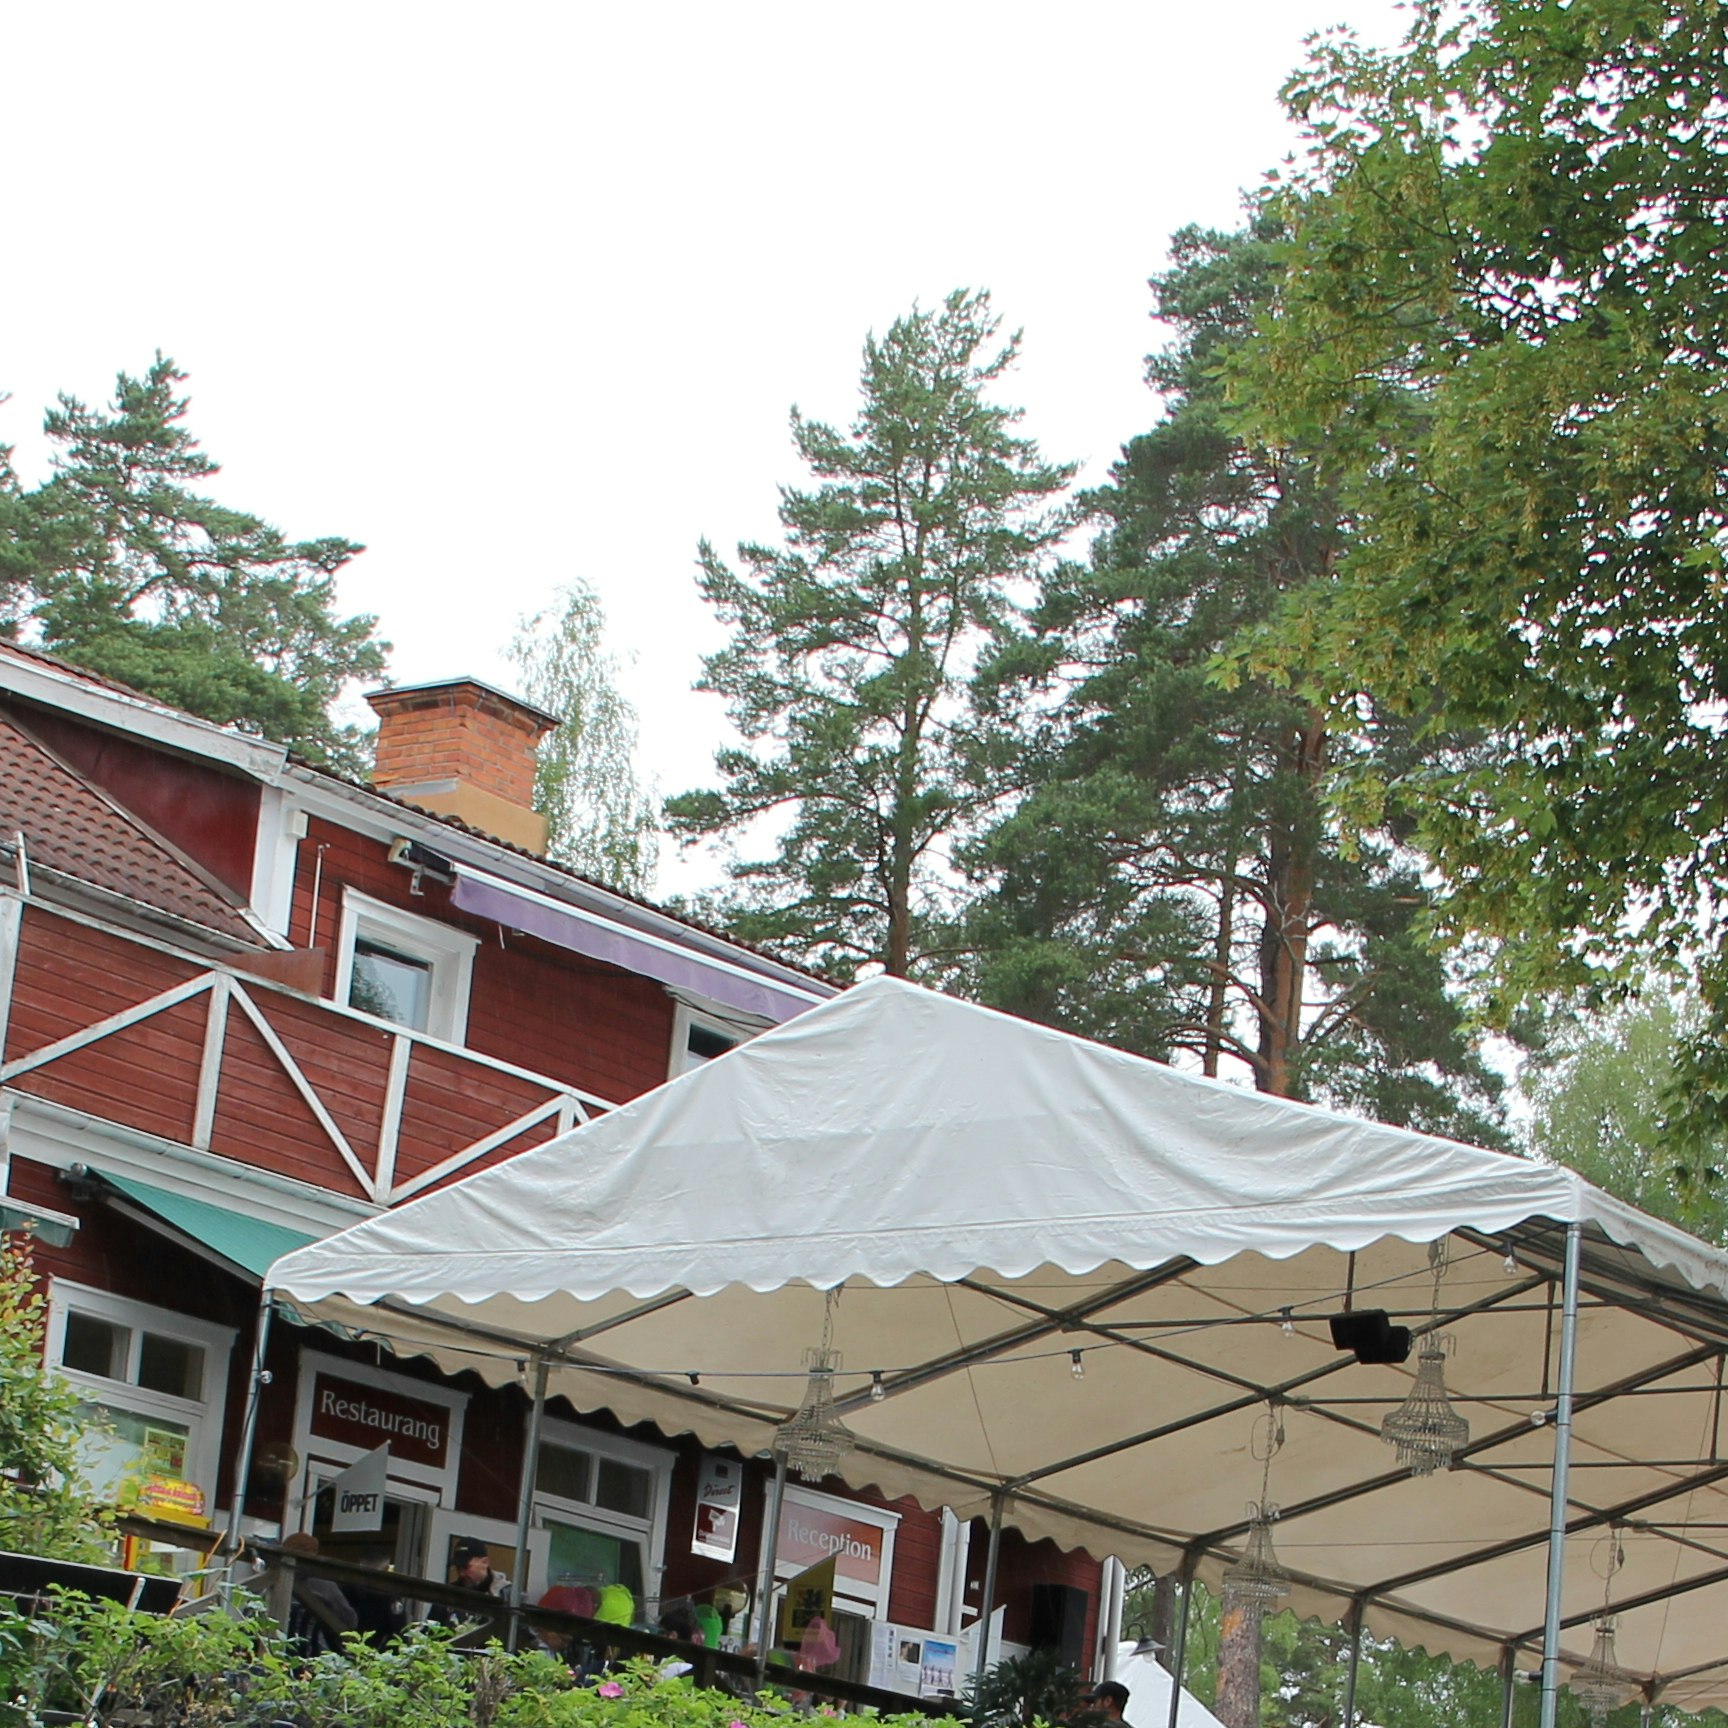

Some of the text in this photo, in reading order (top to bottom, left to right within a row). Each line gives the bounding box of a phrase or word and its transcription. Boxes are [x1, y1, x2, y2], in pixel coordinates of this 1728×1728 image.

[320, 1390, 441, 1450] Restaurang
[340, 1489, 379, 1513] ÖPPET
[788, 1519, 873, 1561] Reception
